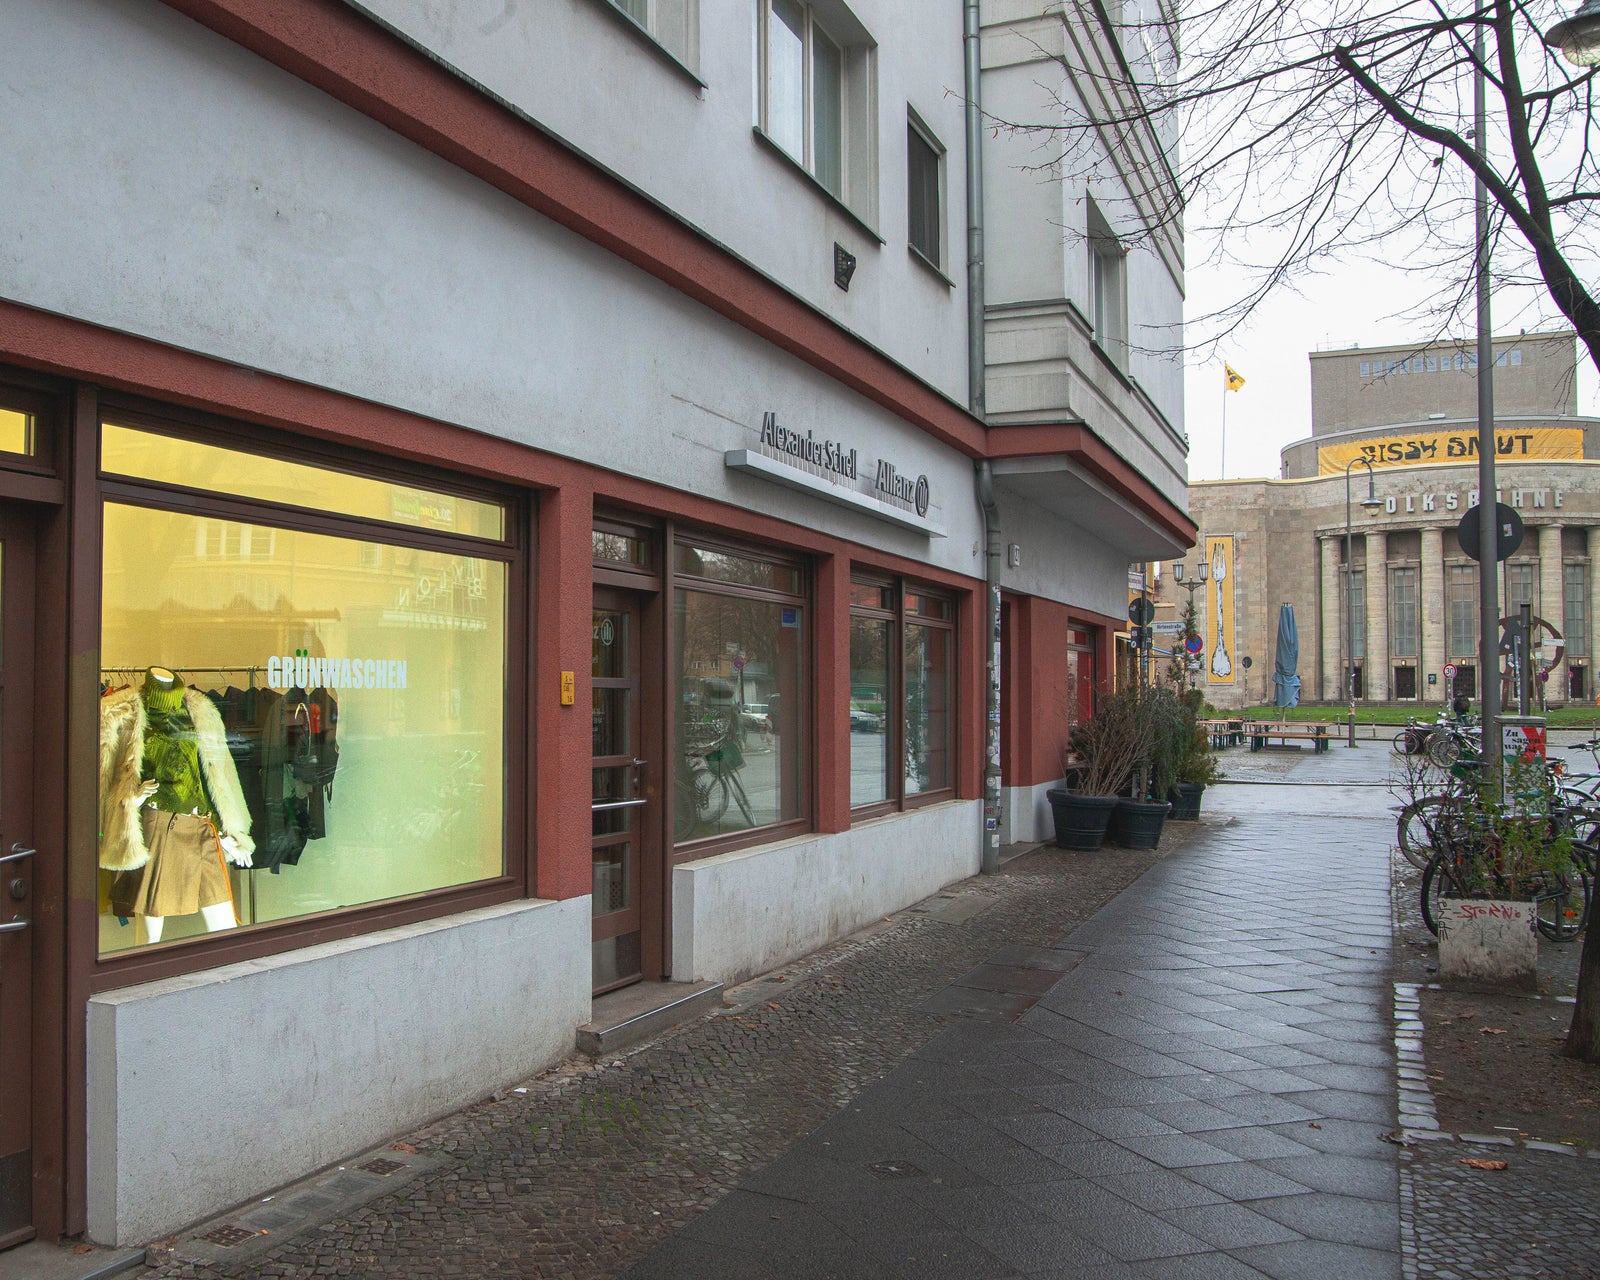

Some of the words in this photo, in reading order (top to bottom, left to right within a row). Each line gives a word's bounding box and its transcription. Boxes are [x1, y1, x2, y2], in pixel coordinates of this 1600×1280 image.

[760, 411, 824, 467] Alexander
[824, 440, 857, 481] Schell
[875, 459, 914, 503] Allianz
[1385, 484, 1564, 515] OLKSBHNE
[267, 648, 408, 689] GRÜNWASCHEN
[1445, 667, 1454, 675] 30
